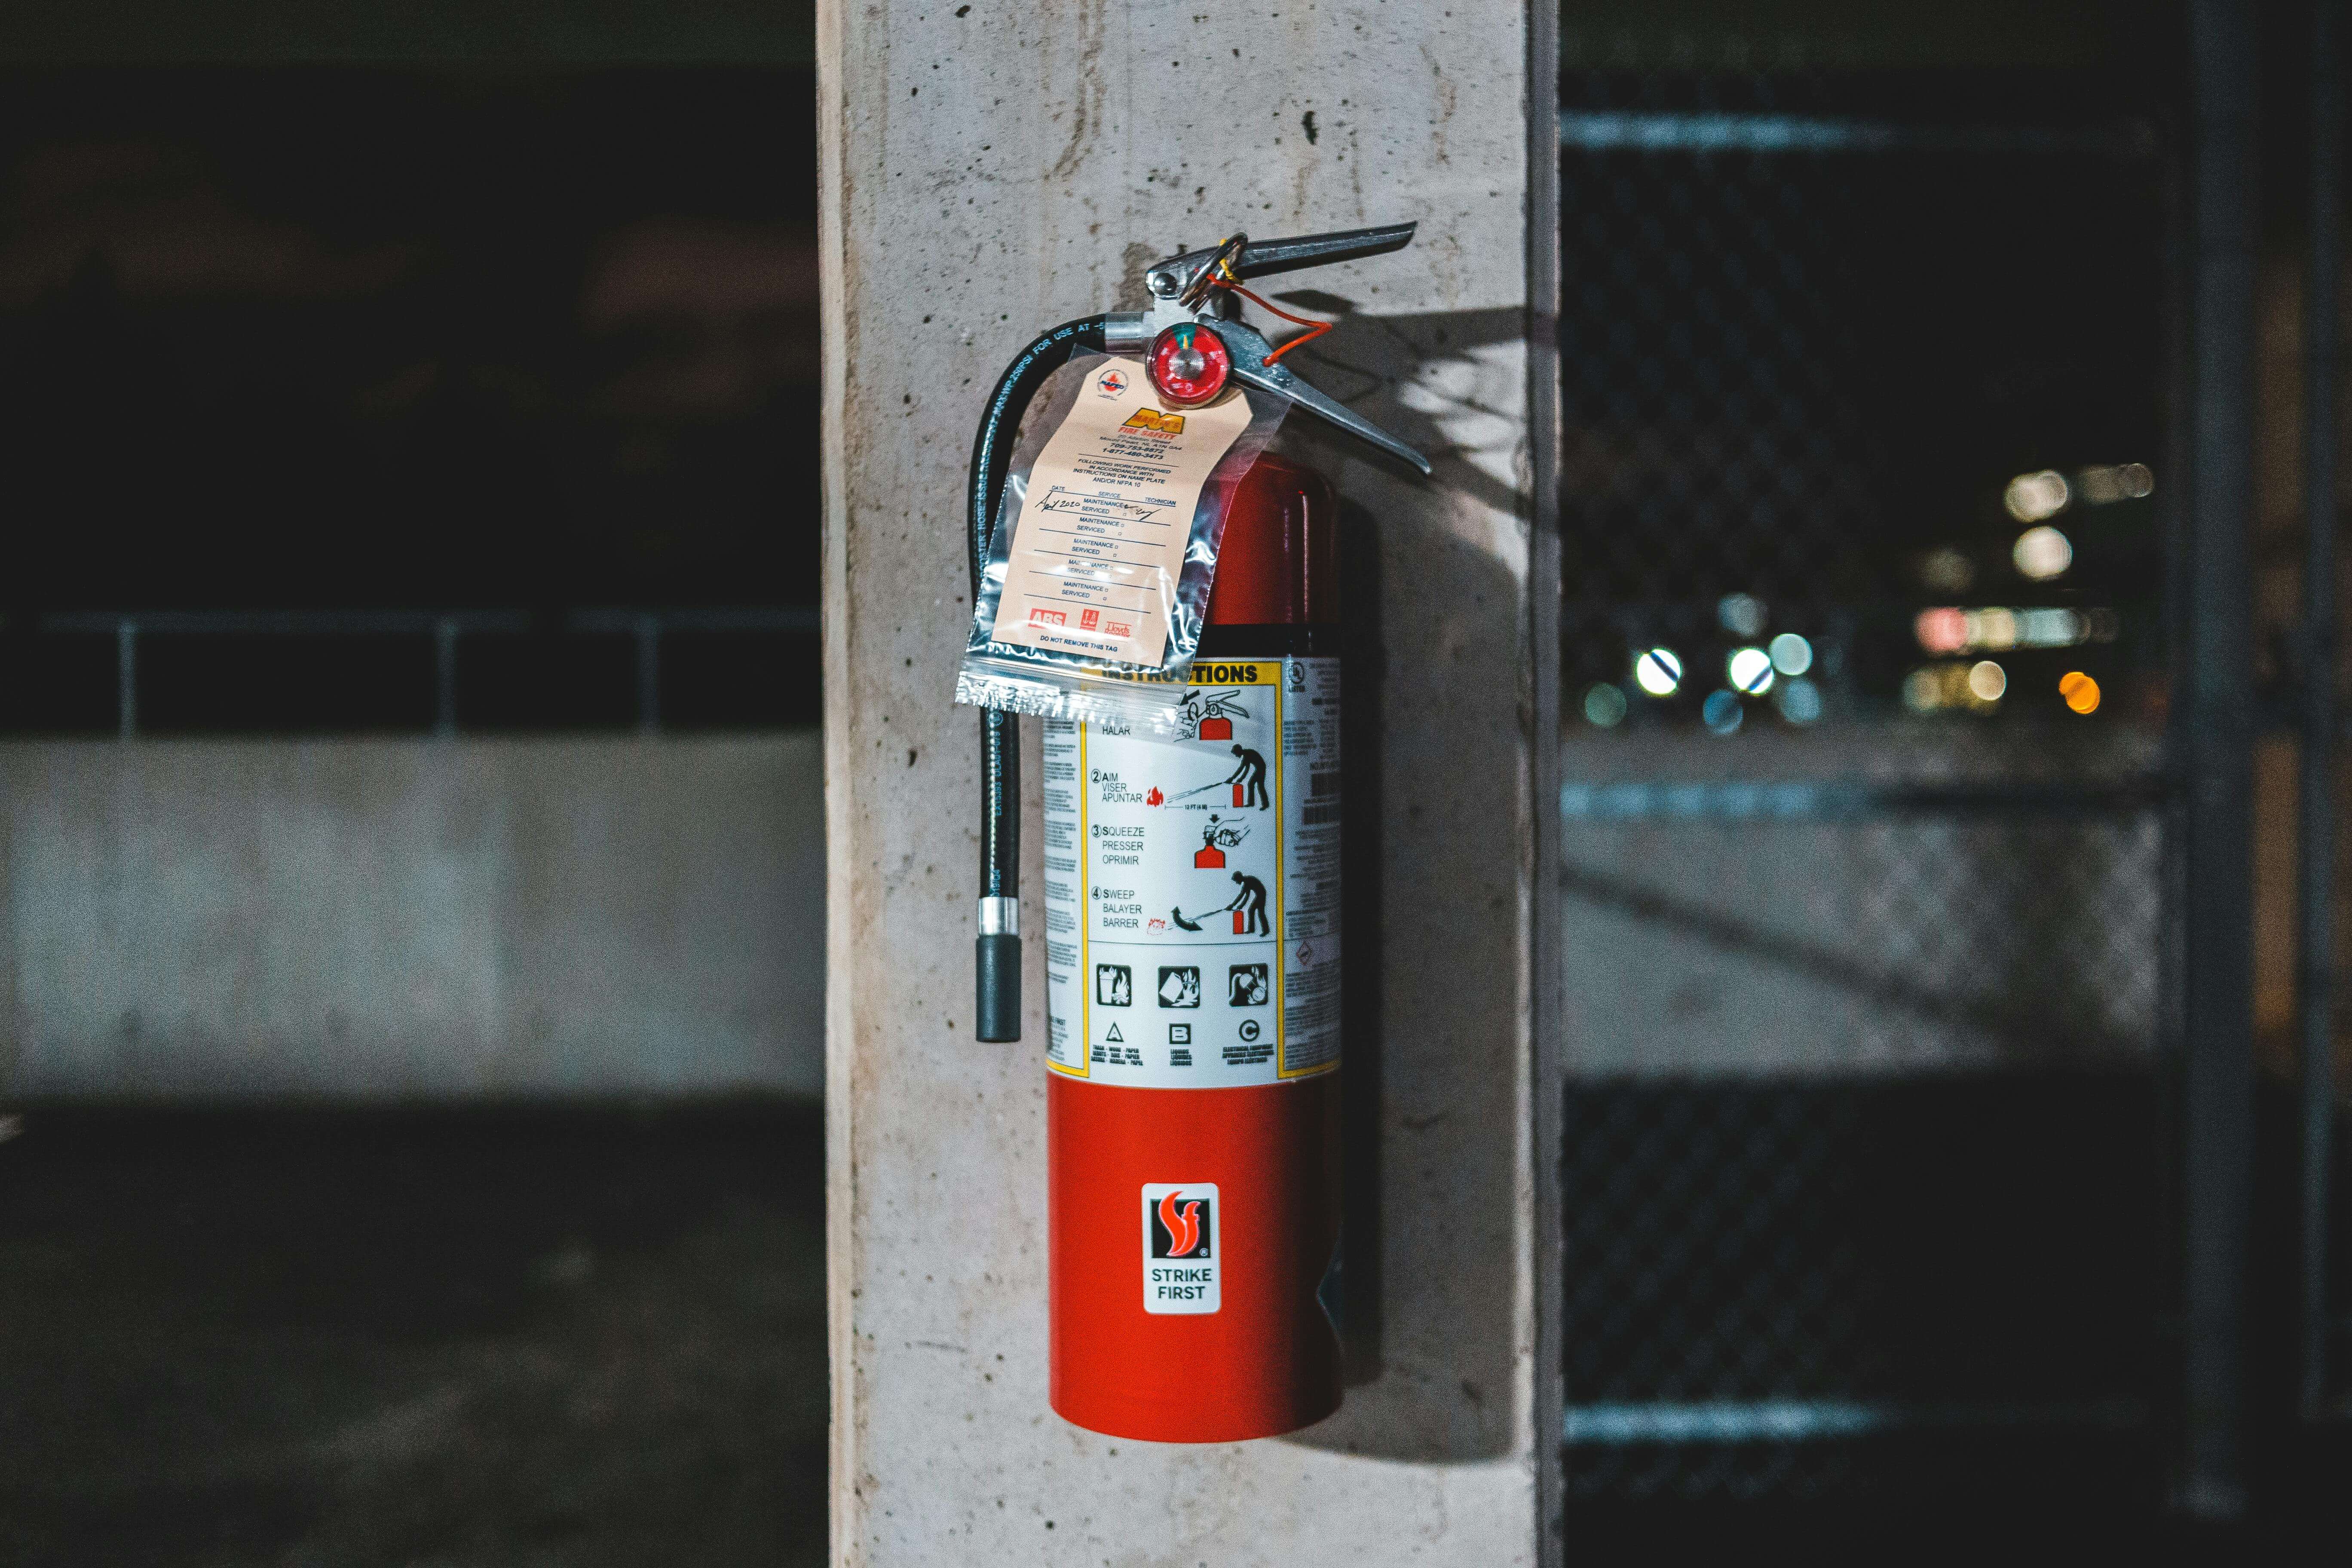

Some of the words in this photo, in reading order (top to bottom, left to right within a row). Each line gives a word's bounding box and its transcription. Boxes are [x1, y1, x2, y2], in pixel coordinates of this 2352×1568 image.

[1032, 338, 1052, 355] FOR
[1053, 327, 1074, 340] USE
[1078, 324, 1090, 332] AT
[1118, 426, 1139, 435] FIRE
[1141, 430, 1177, 439] SAFETY
[1073, 469, 1116, 478] INSTRUCTIONS
[1096, 466, 1137, 475] ACCORDANCE
[1133, 465, 1171, 474] PERFORMED
[1083, 498, 1123, 508] MAINTENANCE
[1145, 497, 1176, 505] TECHNICIAN
[1081, 506, 1109, 514] SERVICED
[977, 506, 986, 530] HOSE
[1079, 517, 1119, 527] MAINTENANCE
[1077, 525, 1105, 533] SERVICED
[1074, 538, 1114, 549] MAINTENANCE
[1072, 546, 1100, 555] SERVICED
[1069, 559, 1109, 570] MAINANCE
[1066, 567, 1095, 576] SERVICED
[1063, 581, 1104, 592] MAINTENANCE
[1062, 589, 1090, 598] SERVICED
[1064, 639, 1088, 648] REMOVE
[1102, 726, 1130, 735] HALAR
[1092, 769, 1100, 782] 2
[1102, 773, 1118, 781] AIM
[1102, 783, 1127, 792] VISER
[1102, 793, 1142, 802] APUNTAR
[1093, 825, 1100, 836] 3
[1102, 826, 1145, 836] SQUEEZE
[1102, 841, 1143, 851] PRESSER
[1102, 855, 1139, 865] OPRIMIR
[1092, 887, 1100, 899] 4
[1103, 889, 1135, 899] SWEEP
[1103, 903, 1142, 914] BALAYER
[1103, 917, 1139, 928] BARRER
[1171, 1026, 1189, 1042] B
[1240, 1020, 1259, 1041] C
[1152, 1268, 1212, 1281] STRIKE
[1158, 1286, 1205, 1299] FIRST
